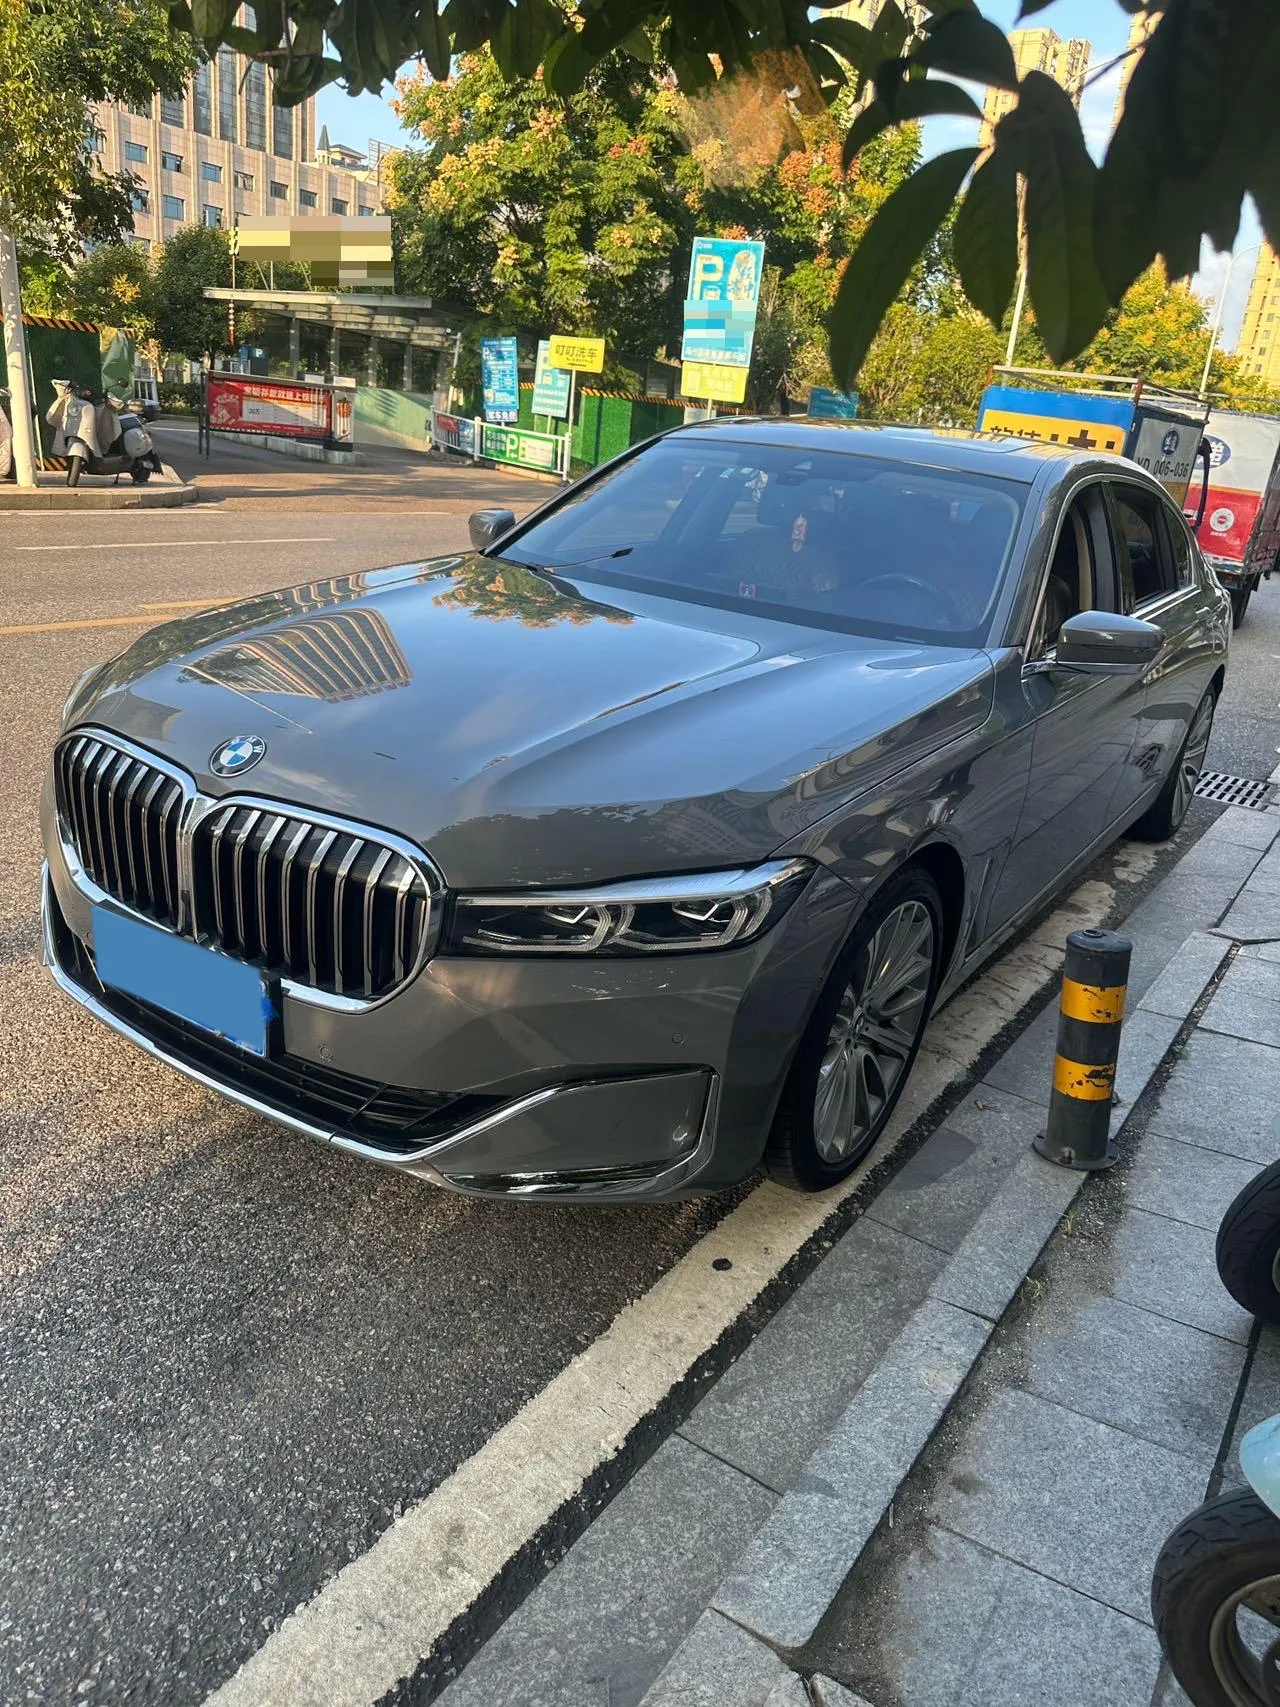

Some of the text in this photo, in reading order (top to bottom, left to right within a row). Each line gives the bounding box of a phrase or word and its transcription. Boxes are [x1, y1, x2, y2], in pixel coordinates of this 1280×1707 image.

[255, 348, 263, 358] P
[555, 344, 598, 359] 叮叮洗车
[506, 433, 519, 458] P
[1153, 460, 1189, 478] 006-036
